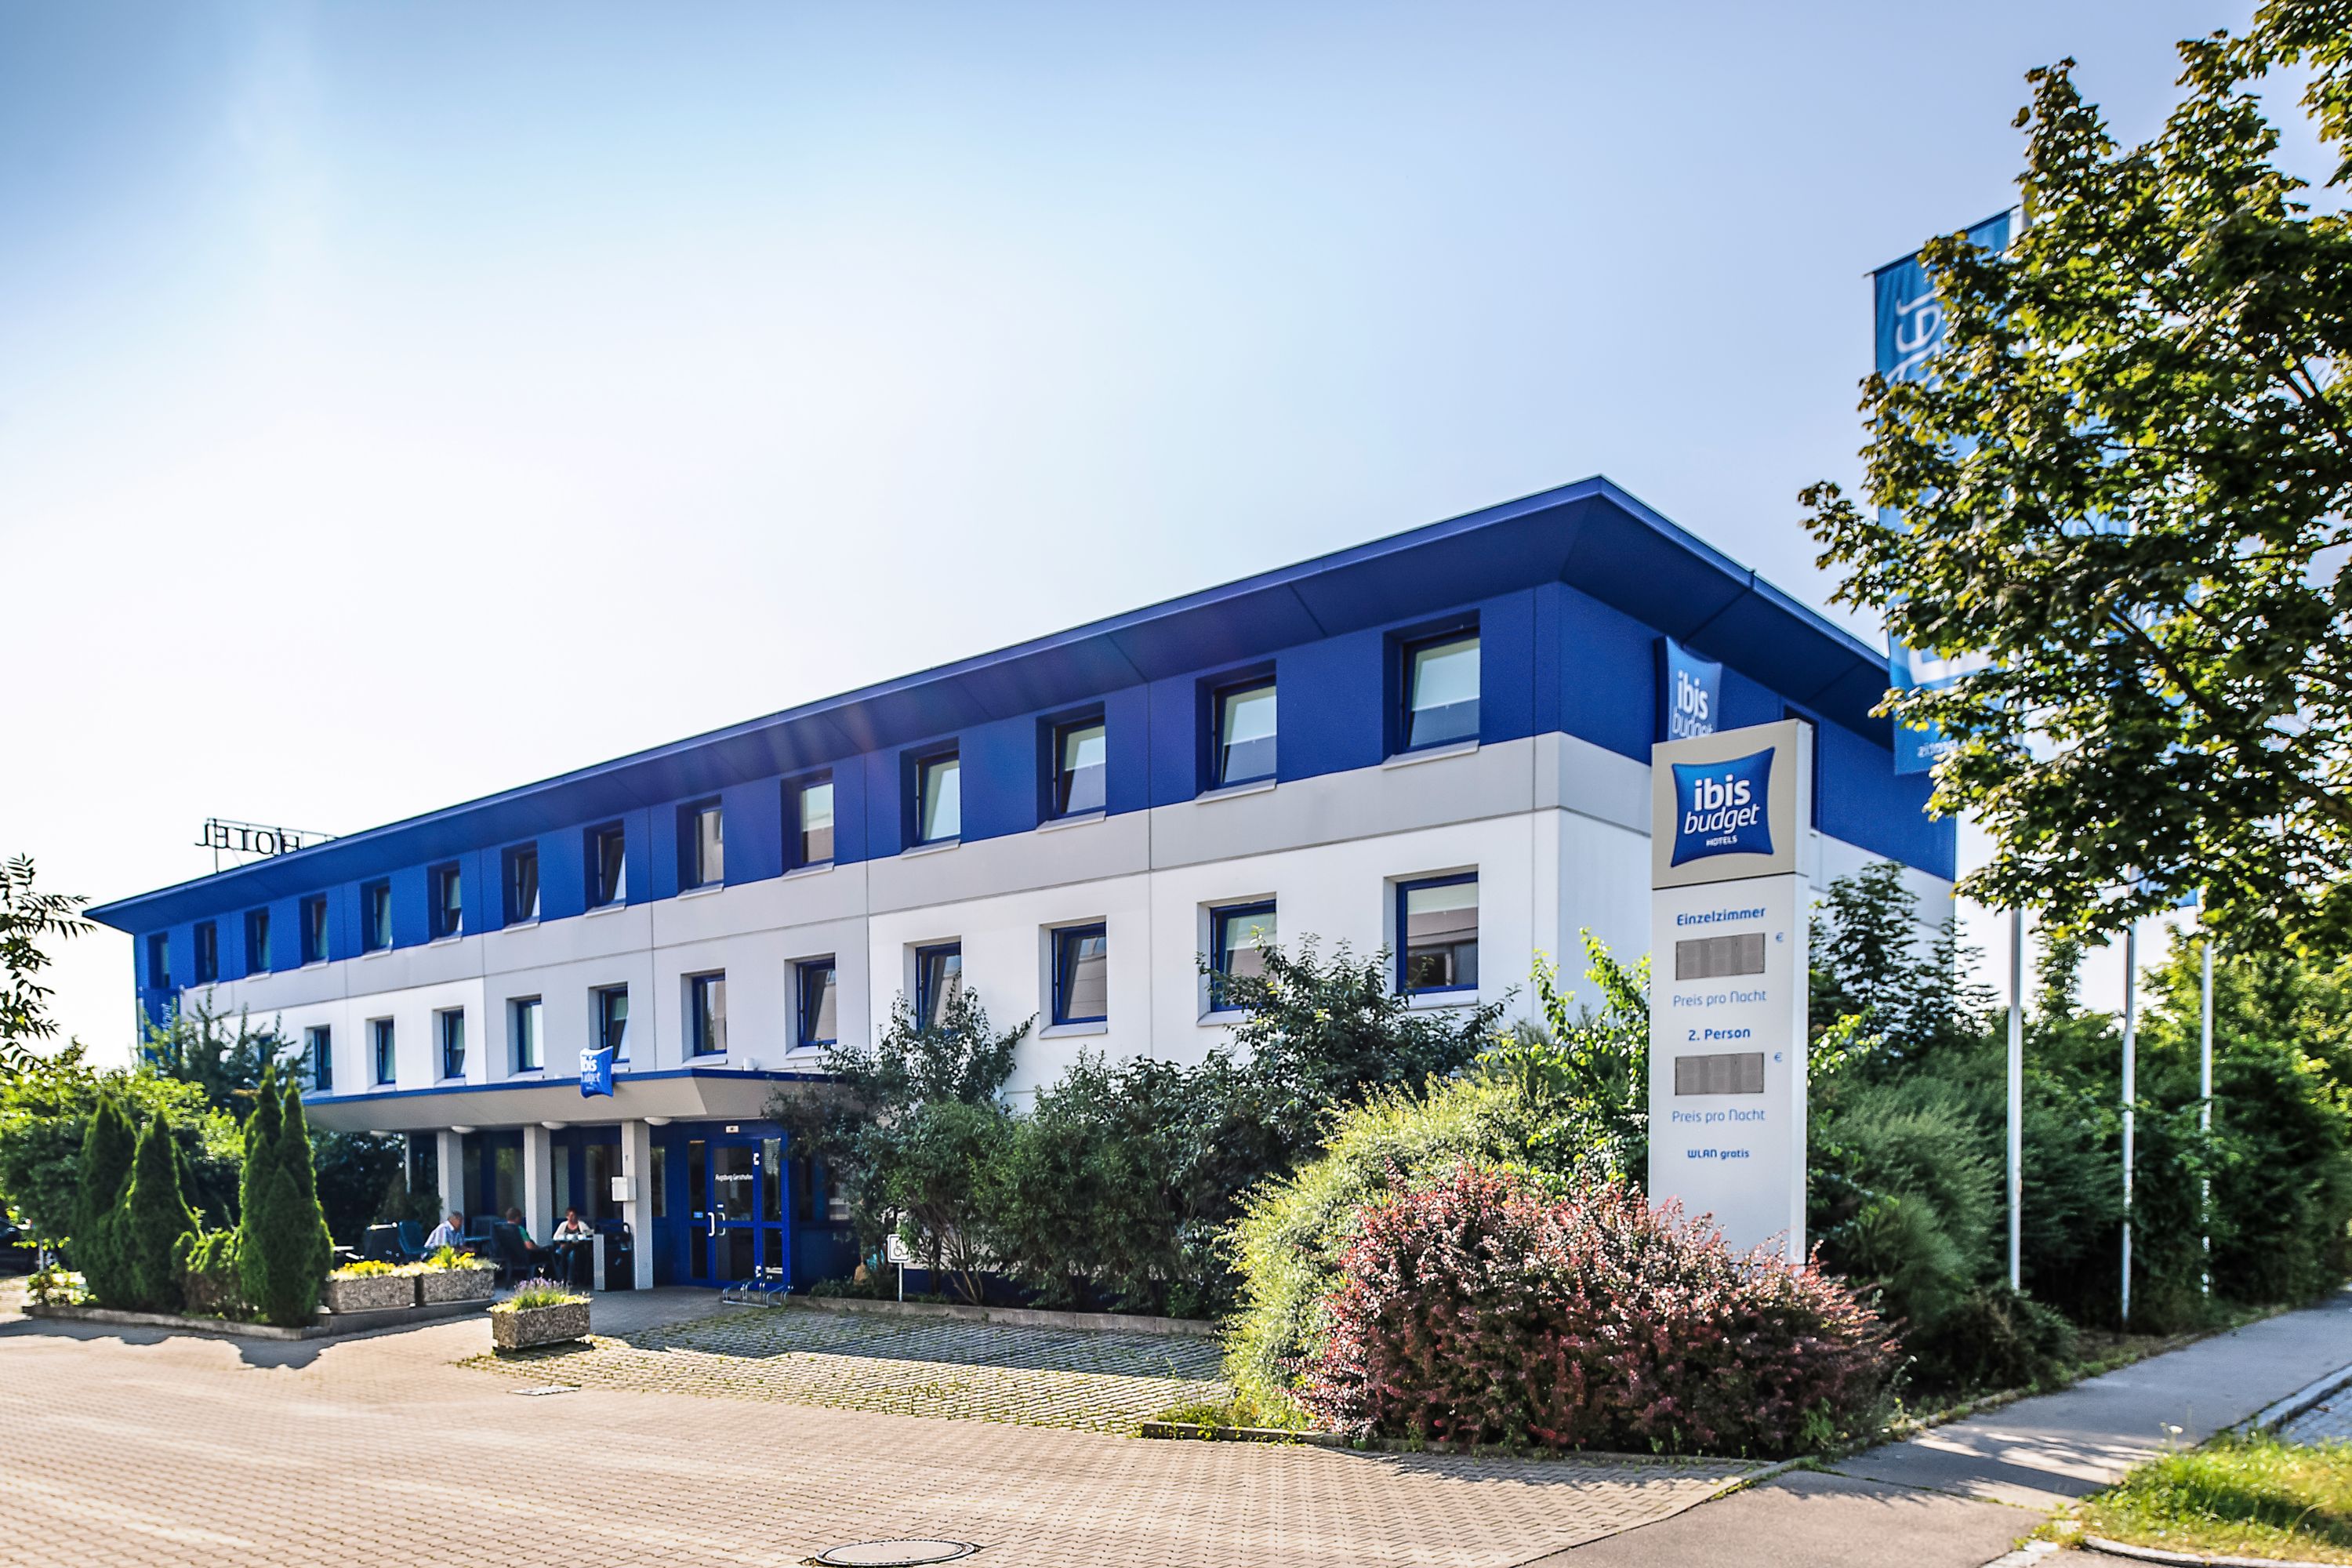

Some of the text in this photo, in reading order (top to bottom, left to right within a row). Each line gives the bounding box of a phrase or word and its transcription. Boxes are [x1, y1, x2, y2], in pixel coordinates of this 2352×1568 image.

[1677, 669, 1708, 720] ibis
[1694, 774, 1751, 811] ibis
[1684, 803, 1761, 835] budget
[1705, 834, 1738, 848] HOTELS
[1676, 907, 1766, 927] Einzelzimmer
[1775, 931, 1784, 943] €
[1673, 990, 1767, 1008] Preis pro Nacht
[1688, 1028, 1751, 1042] 2. Person
[1774, 1051, 1783, 1063] €
[1672, 1108, 1766, 1124] Preis pro Nacht
[1686, 1149, 1750, 1160] WLAN gratis
